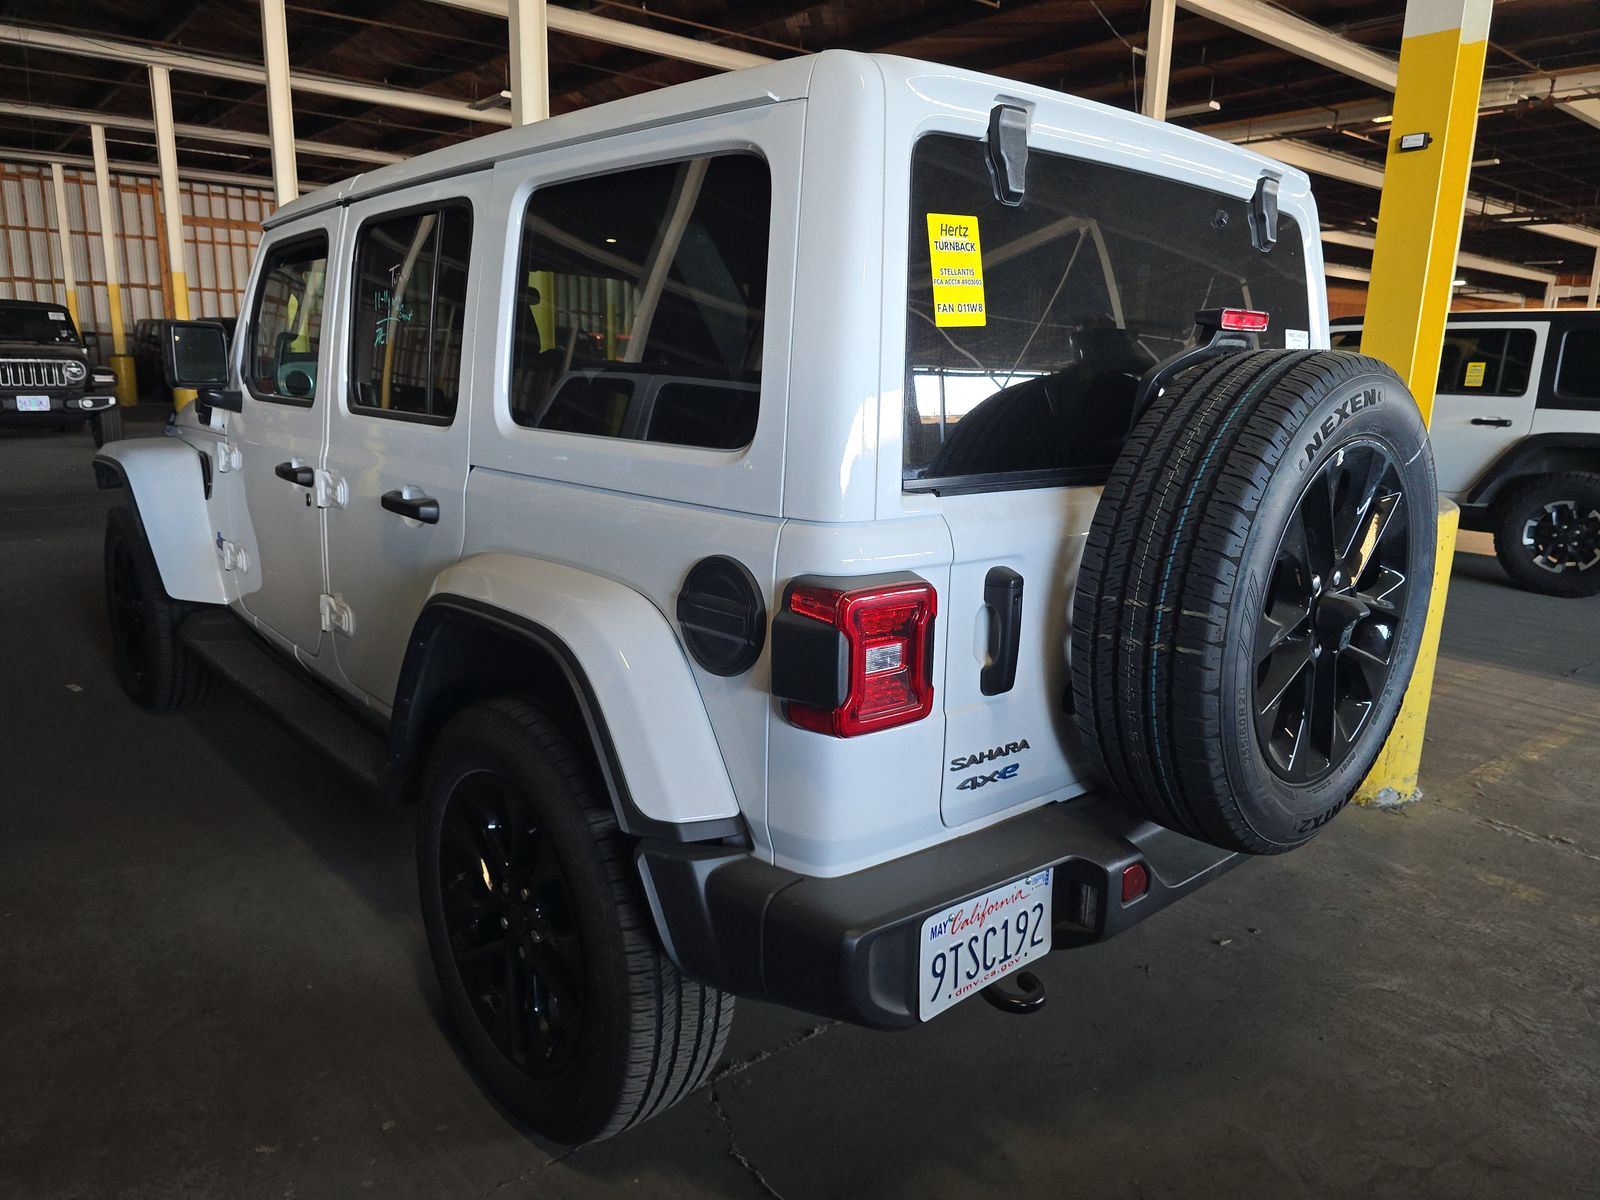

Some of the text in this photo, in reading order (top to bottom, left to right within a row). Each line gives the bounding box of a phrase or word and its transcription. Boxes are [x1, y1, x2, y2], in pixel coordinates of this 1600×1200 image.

[934, 240, 976, 252] TURNBACK
[940, 223, 969, 238] Hertz
[940, 267, 975, 276] STELLANTIS
[937, 303, 983, 313] FAN 011W8
[1305, 388, 1377, 462] NEXEN
[950, 739, 1030, 771] SAHARA
[930, 886, 1030, 941] MAY California
[931, 902, 1044, 1003] 9TSC192
[955, 955, 1021, 997] dmv.ca.gov
